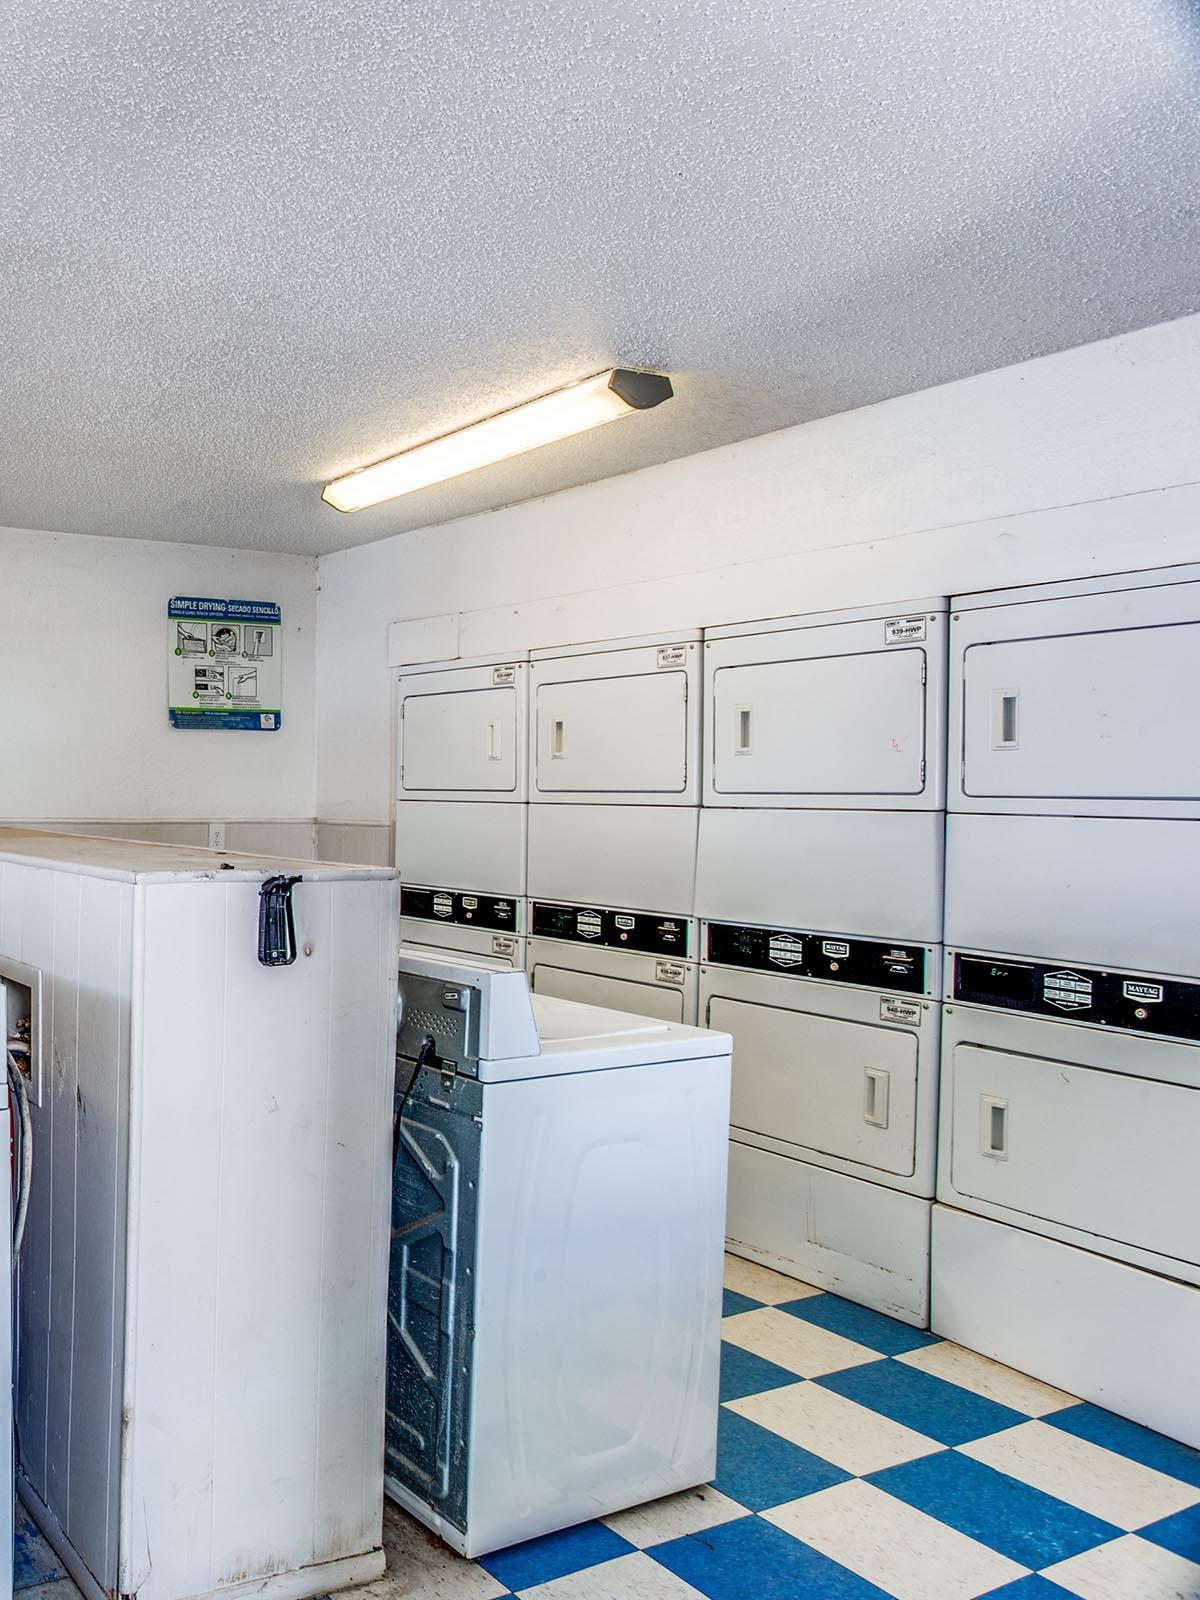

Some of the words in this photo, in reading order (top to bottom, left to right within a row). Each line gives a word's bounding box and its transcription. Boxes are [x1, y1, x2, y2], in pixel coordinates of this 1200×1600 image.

[170, 600, 197, 610] SIMPLE
[199, 602, 226, 612] DRYING
[227, 604, 251, 613] SECADO
[252, 605, 279, 615] SENCILLO
[1128, 985, 1158, 994] MAYTAG
